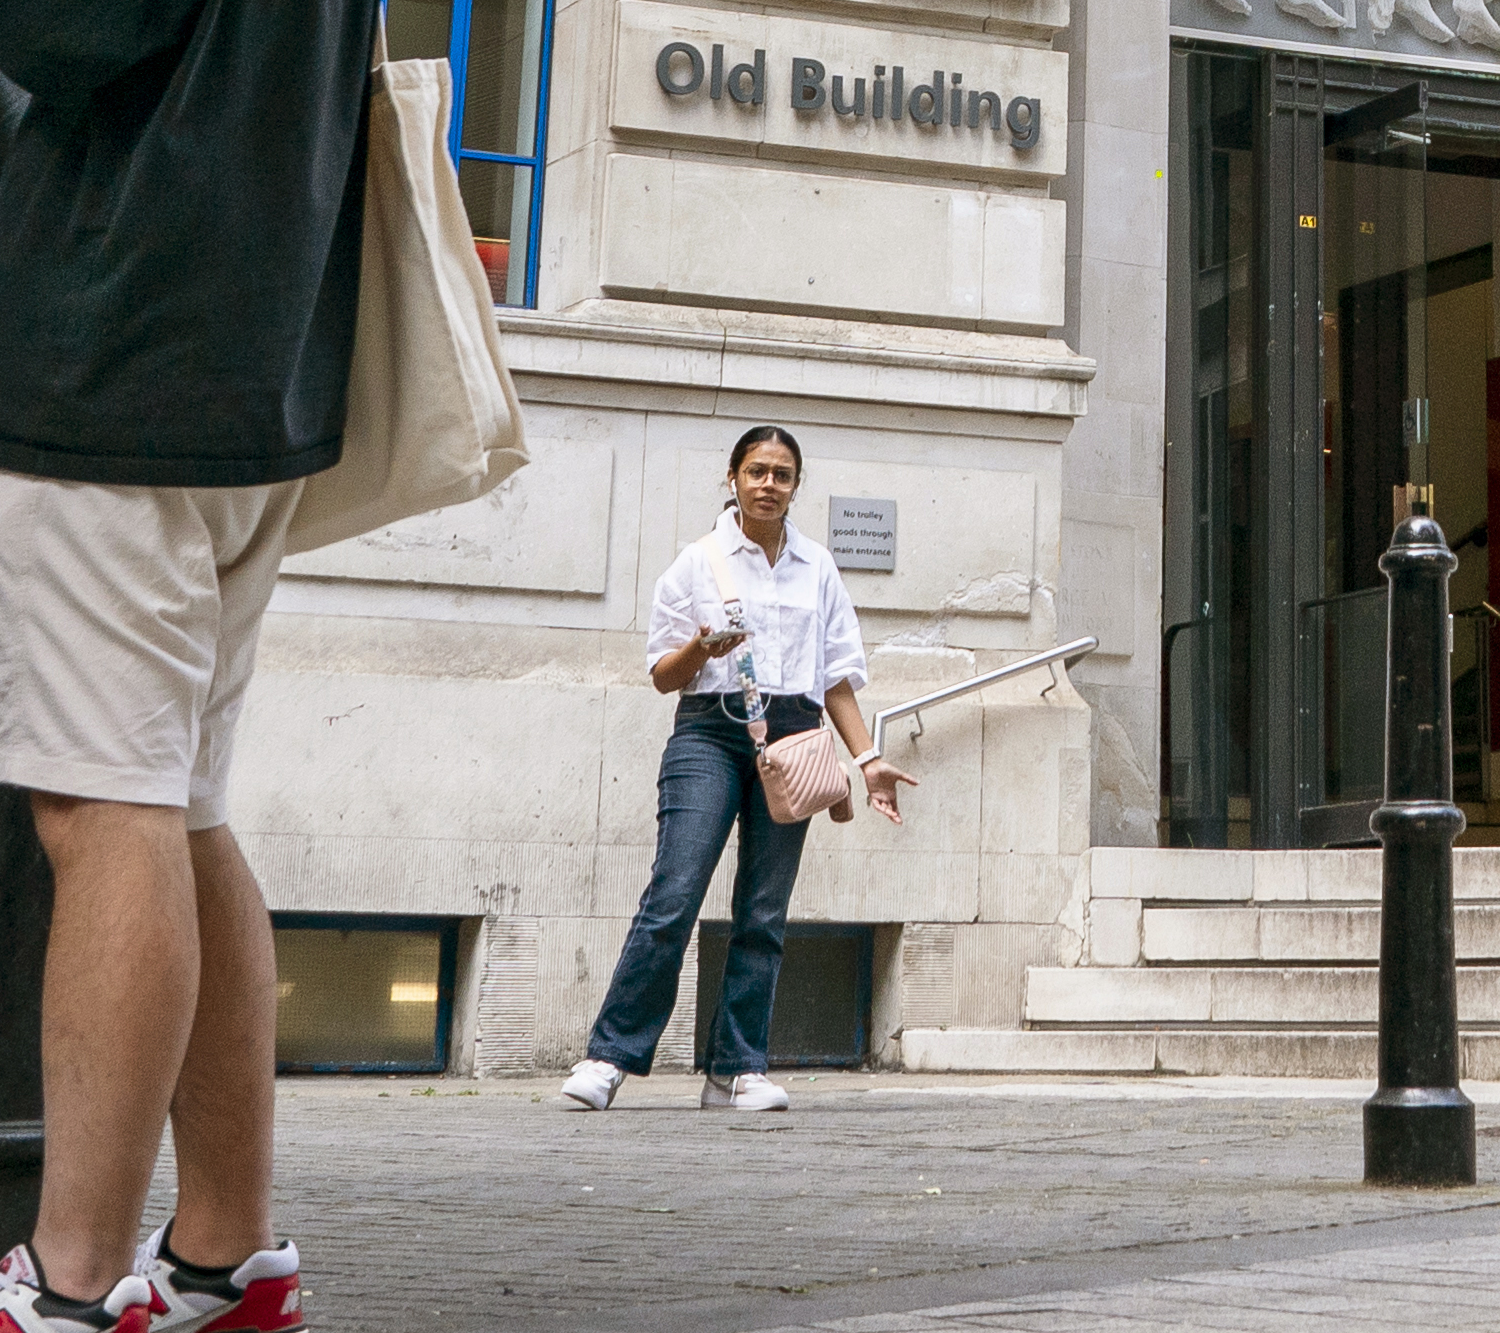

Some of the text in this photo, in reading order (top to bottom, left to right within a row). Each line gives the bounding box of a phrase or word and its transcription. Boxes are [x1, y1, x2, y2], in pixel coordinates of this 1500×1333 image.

[655, 41, 1041, 148] Old Building
[1301, 216, 1315, 227] A1
[843, 510, 883, 522] No trolley
[833, 528, 893, 540] goods through
[833, 546, 891, 556] main entrance
